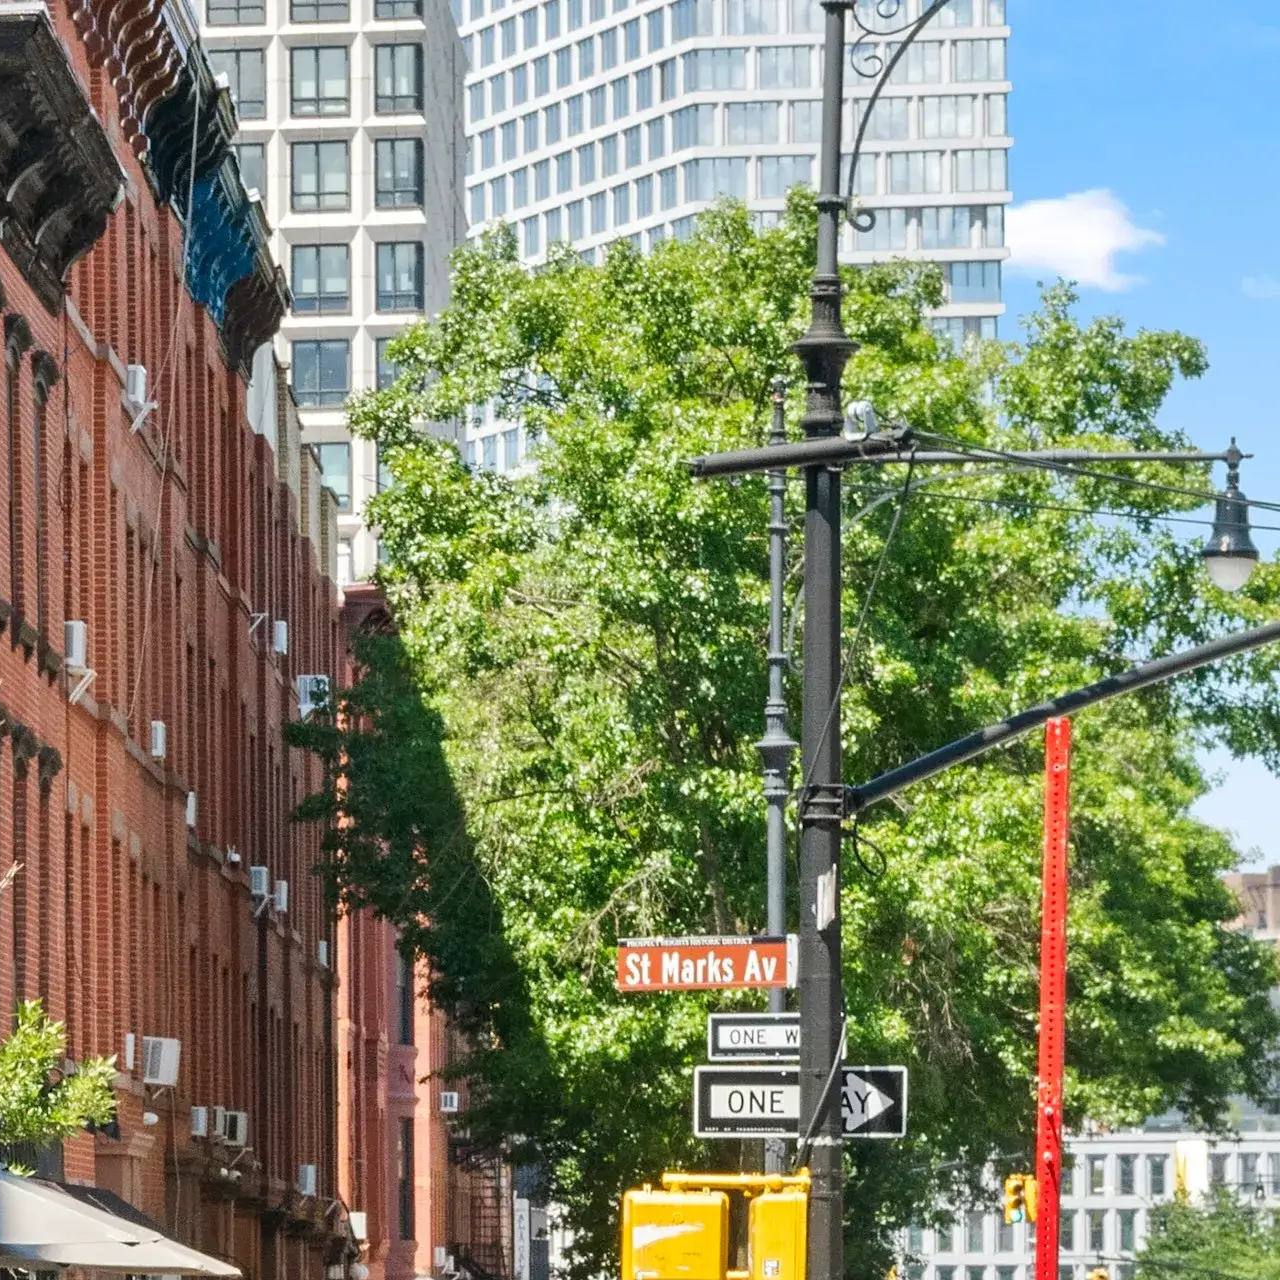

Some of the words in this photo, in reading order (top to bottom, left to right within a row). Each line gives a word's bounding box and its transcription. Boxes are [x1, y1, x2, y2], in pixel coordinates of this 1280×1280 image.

[624, 952, 652, 986] St
[661, 950, 735, 985] Marks
[743, 949, 778, 983] Av
[729, 1028, 768, 1045] ONE
[727, 1089, 785, 1114] ONE
[841, 1089, 872, 1115] AY
